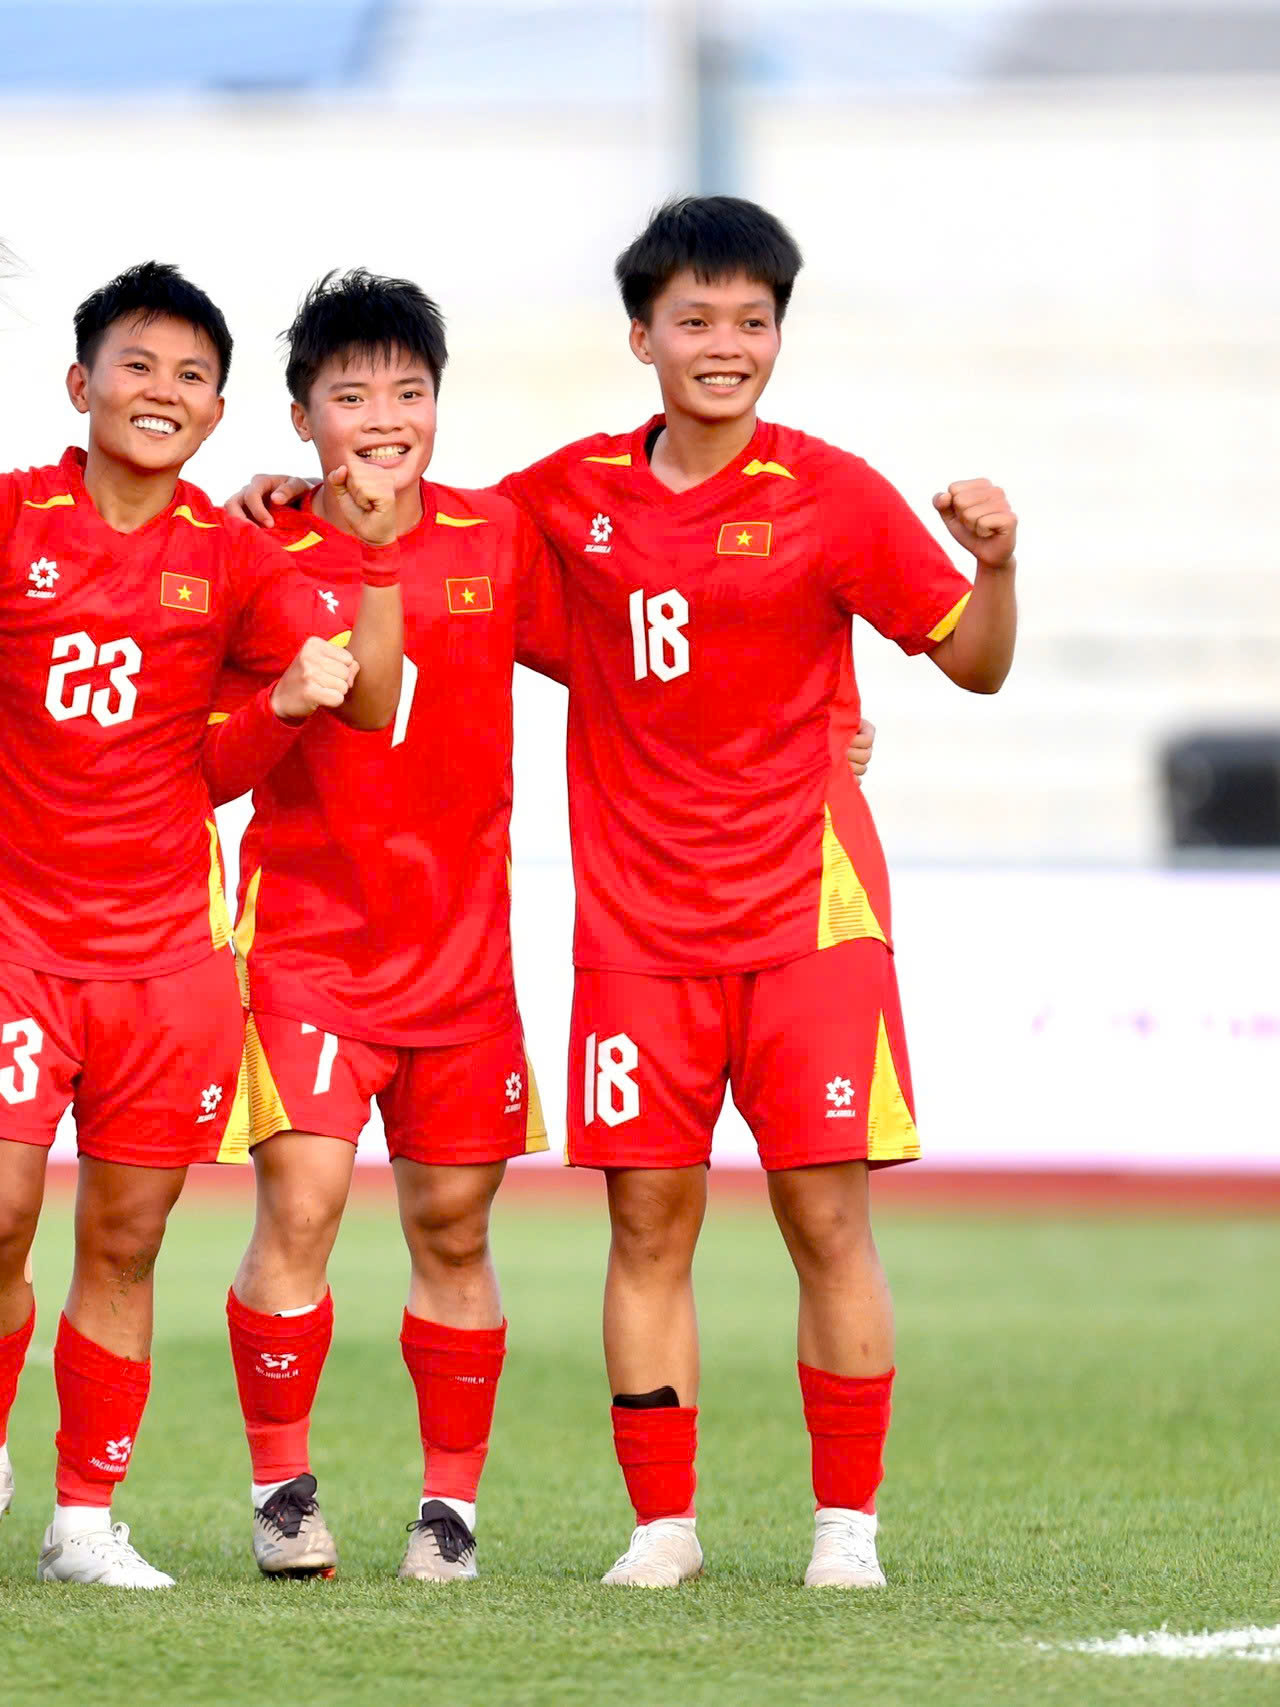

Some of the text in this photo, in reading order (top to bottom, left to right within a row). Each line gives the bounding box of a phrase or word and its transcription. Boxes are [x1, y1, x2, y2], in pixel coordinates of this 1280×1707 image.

[44, 631, 143, 728] 23
[629, 588, 690, 683] 18
[300, 1022, 339, 1096] 7
[584, 1032, 640, 1128] 18
